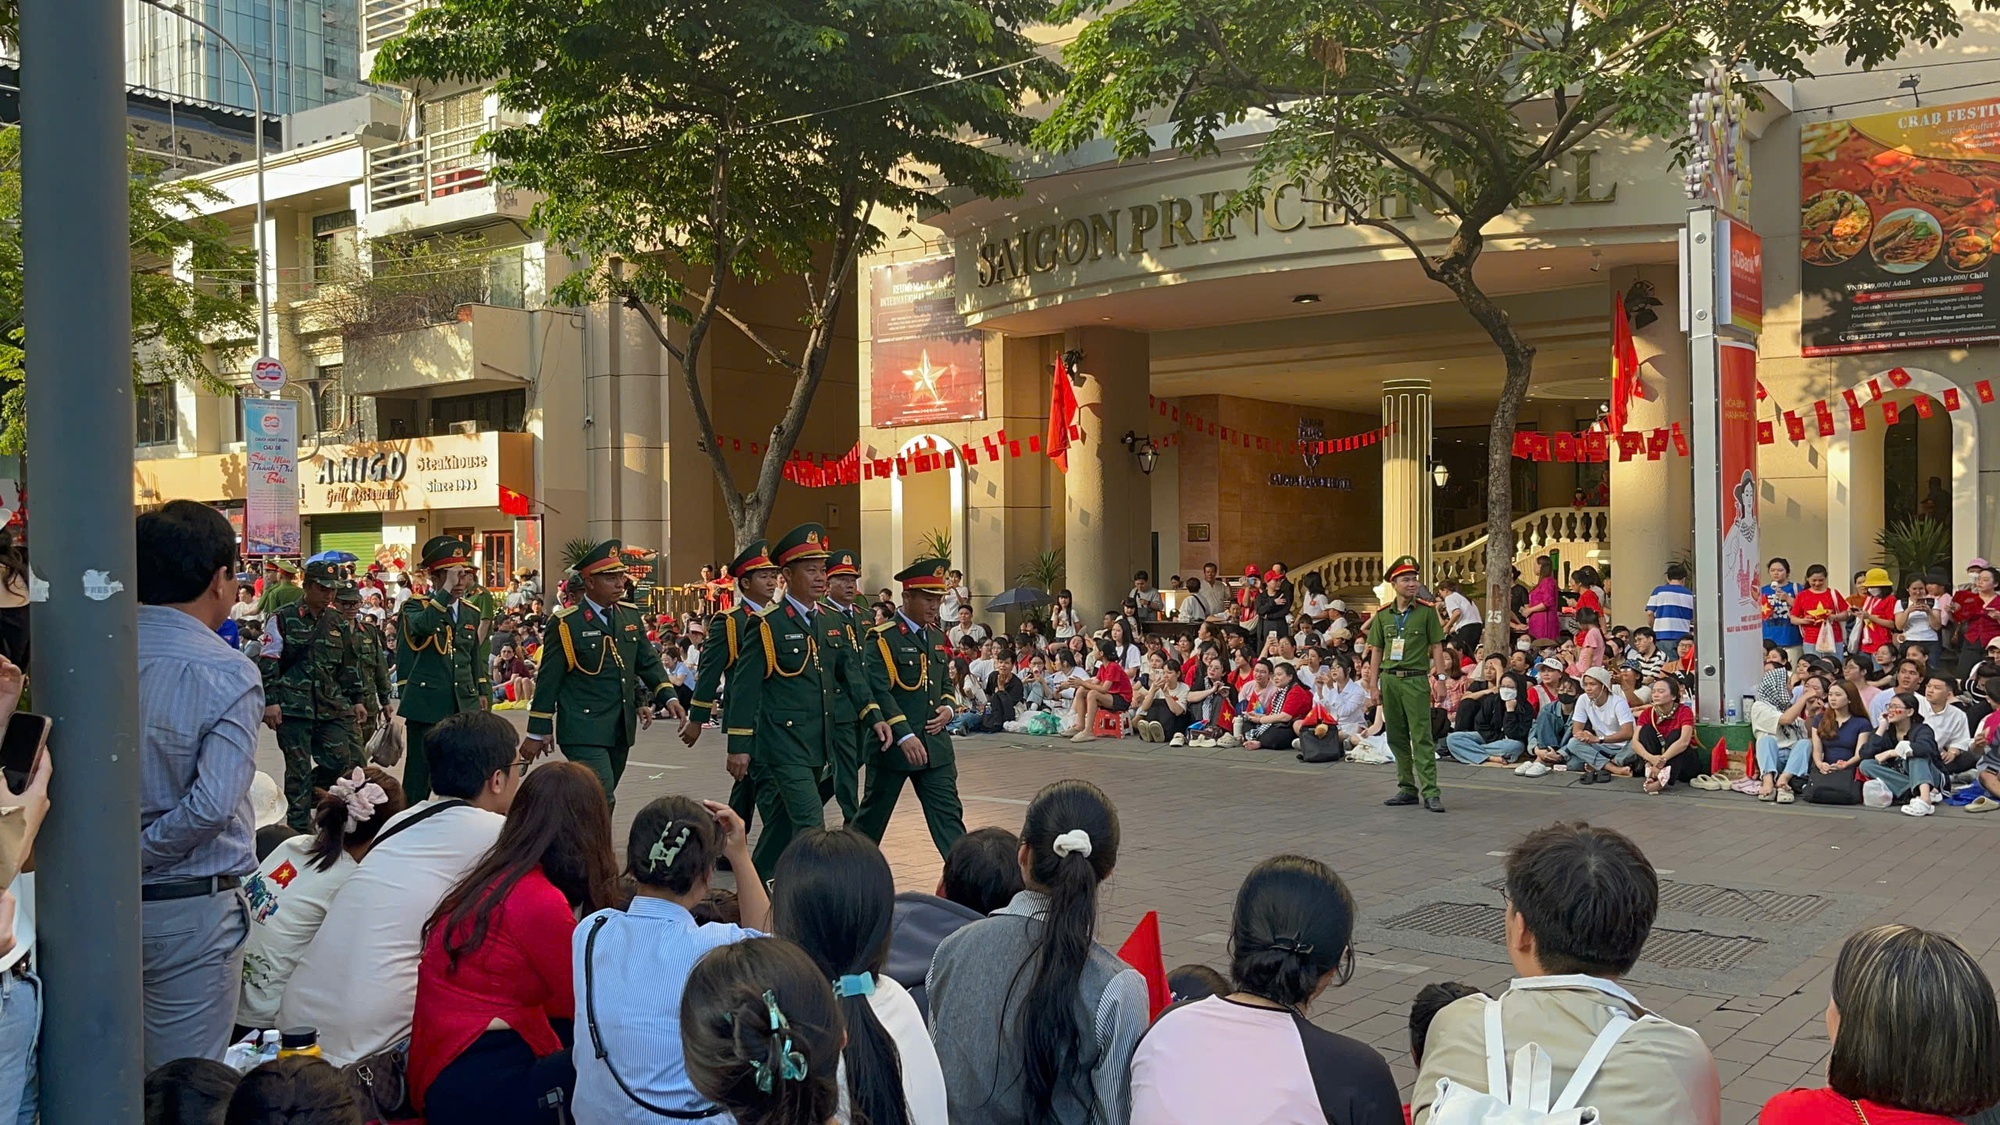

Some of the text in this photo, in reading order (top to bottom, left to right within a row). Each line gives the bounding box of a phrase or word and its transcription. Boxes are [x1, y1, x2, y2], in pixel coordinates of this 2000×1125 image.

[1897, 112, 1941, 129] CRAB
[977, 209, 1121, 288] SAIGON
[1128, 170, 1349, 254] PRINCE
[1969, 271, 1989, 279] Child
[1846, 283, 1862, 291] VND
[1893, 279, 1911, 287] Adult
[315, 451, 407, 485] AMIGO
[416, 454, 488, 472] Steakhouse
[327, 486, 349, 508] Grill
[1488, 609, 1502, 624] 25
